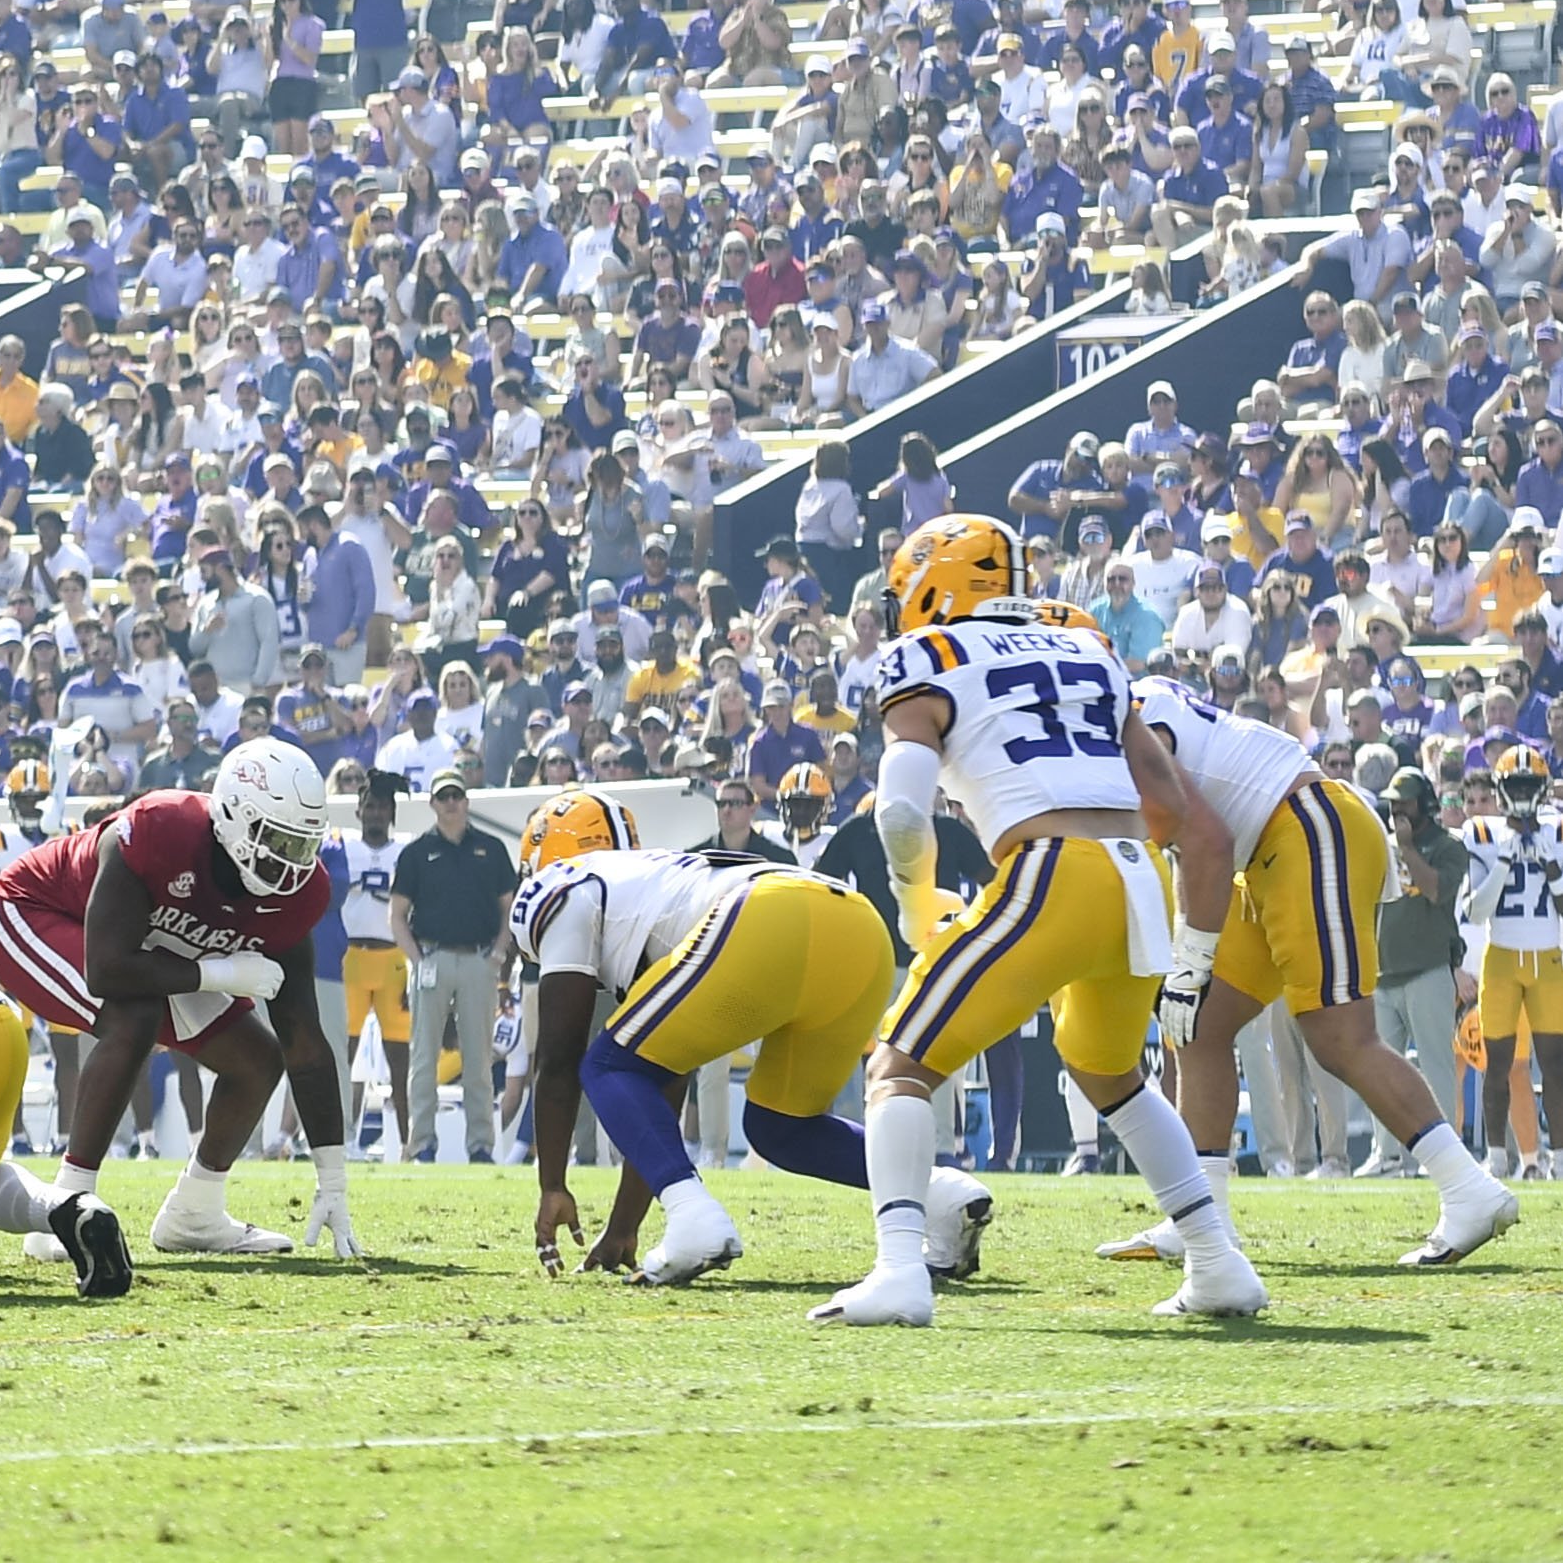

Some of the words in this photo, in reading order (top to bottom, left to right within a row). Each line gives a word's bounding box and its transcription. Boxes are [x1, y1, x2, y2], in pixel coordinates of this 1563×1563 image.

[1168, 47, 1190, 88] 7
[982, 633, 1081, 656] WEEKS
[985, 659, 1125, 765] 33
[1381, 717, 1420, 737] LSU
[1495, 862, 1551, 917] 27
